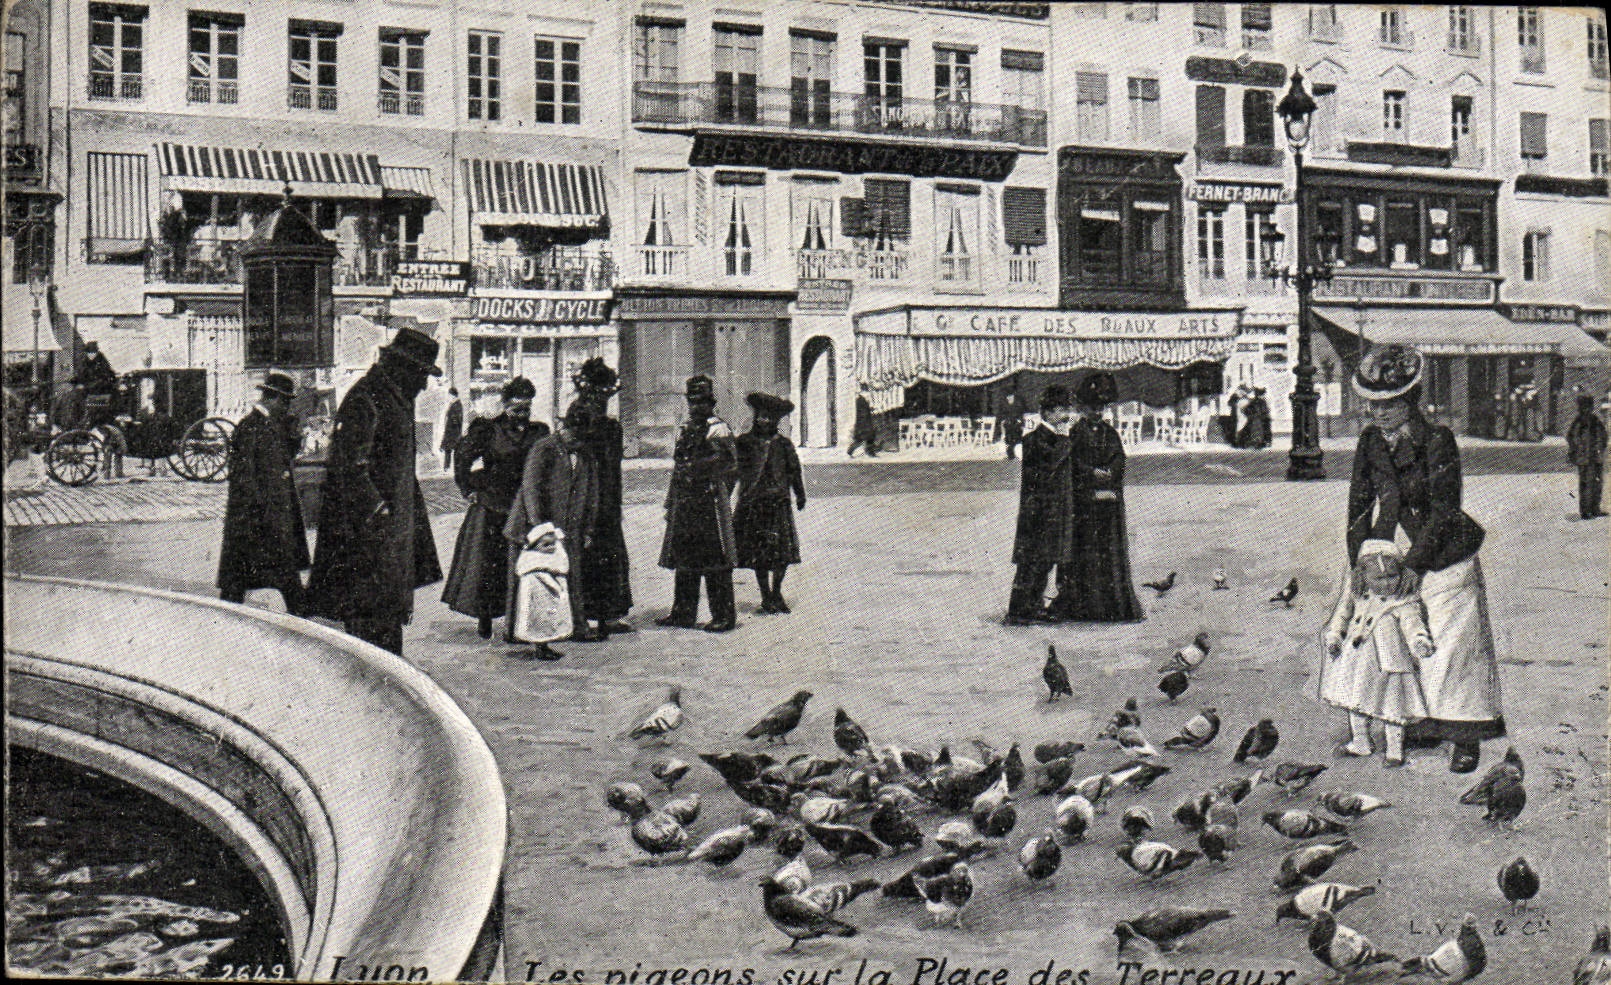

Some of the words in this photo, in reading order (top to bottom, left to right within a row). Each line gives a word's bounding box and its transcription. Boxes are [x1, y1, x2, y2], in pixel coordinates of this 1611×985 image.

[478, 298, 535, 318] DOCKS
[554, 300, 606, 320] CYCLE
[1043, 318, 1078, 335] DES
[1178, 316, 1220, 335] ARTS
